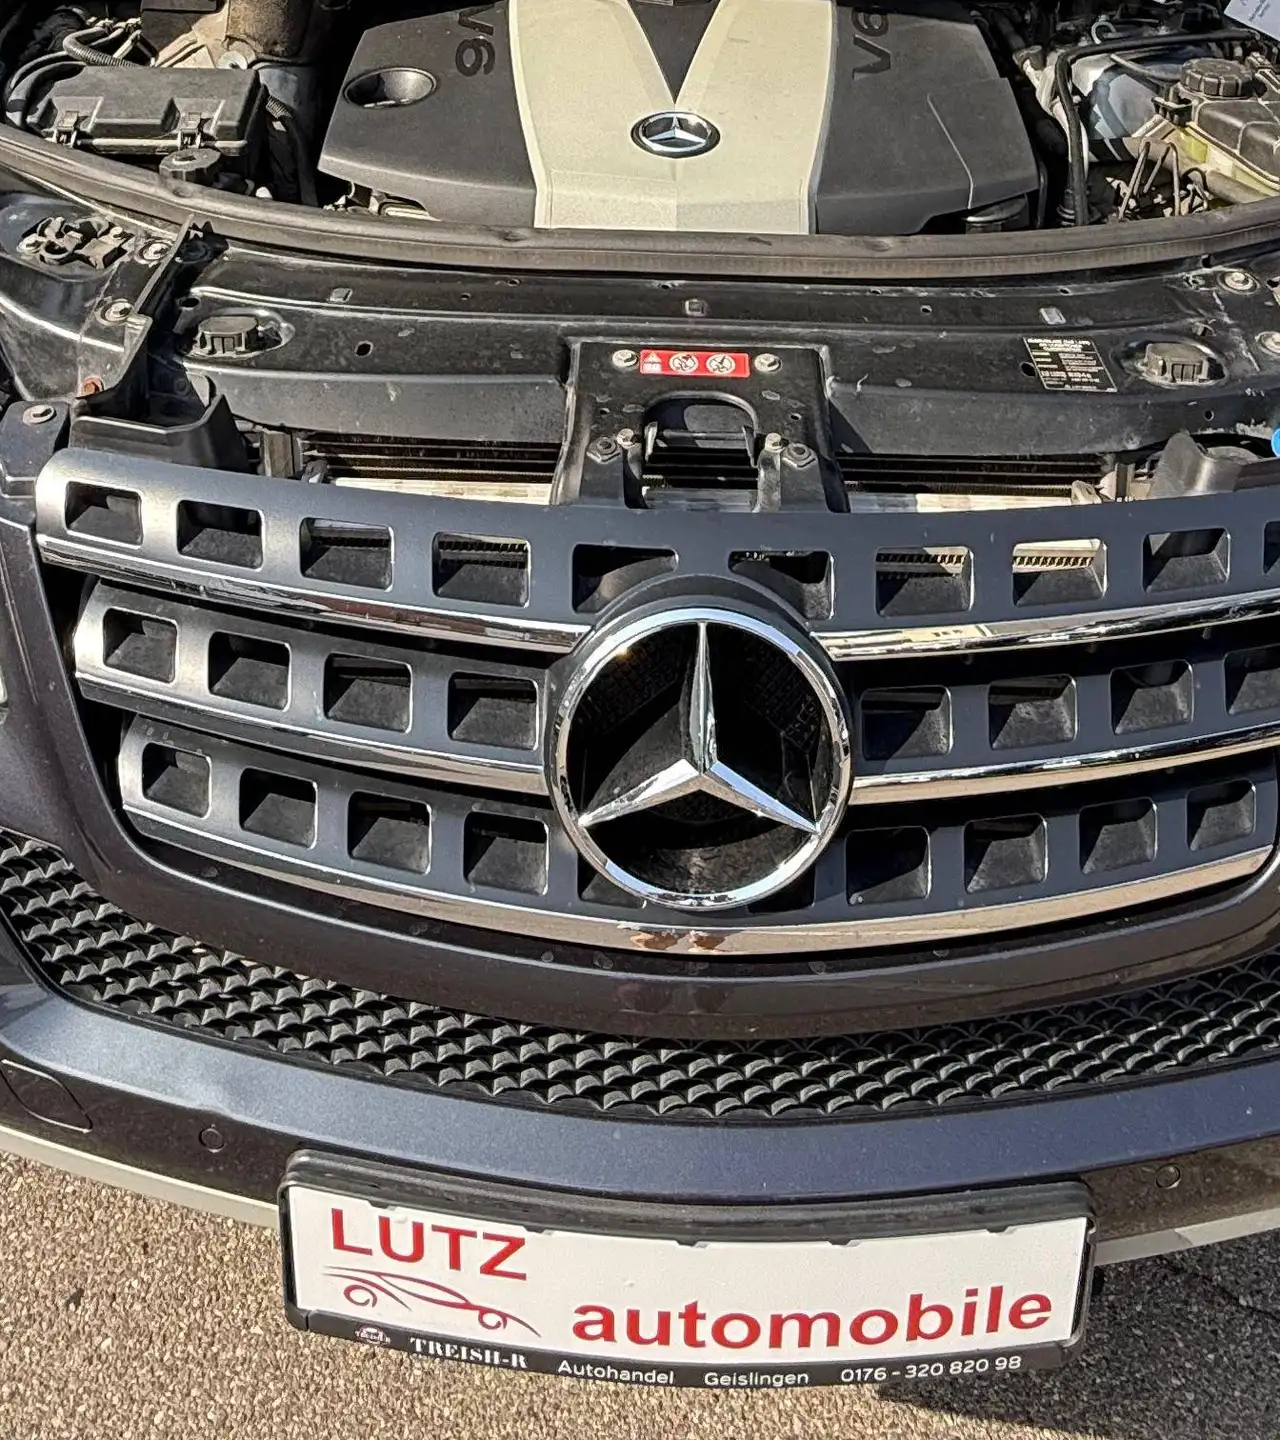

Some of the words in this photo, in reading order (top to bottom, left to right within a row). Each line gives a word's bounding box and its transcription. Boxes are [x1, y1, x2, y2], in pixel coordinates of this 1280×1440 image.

[455, 2, 496, 78] V6
[851, 6, 892, 80] V6
[330, 1207, 528, 1281] LUTZ
[572, 1284, 1054, 1350] automobile
[410, 1336, 528, 1369] TREISH-R
[557, 1359, 676, 1386] Autohandel
[704, 1369, 810, 1388] Geislingen
[841, 1365, 887, 1384] 0176
[904, 1361, 945, 1378] 320
[948, 1358, 990, 1376] 820
[994, 1355, 1022, 1371] 98
